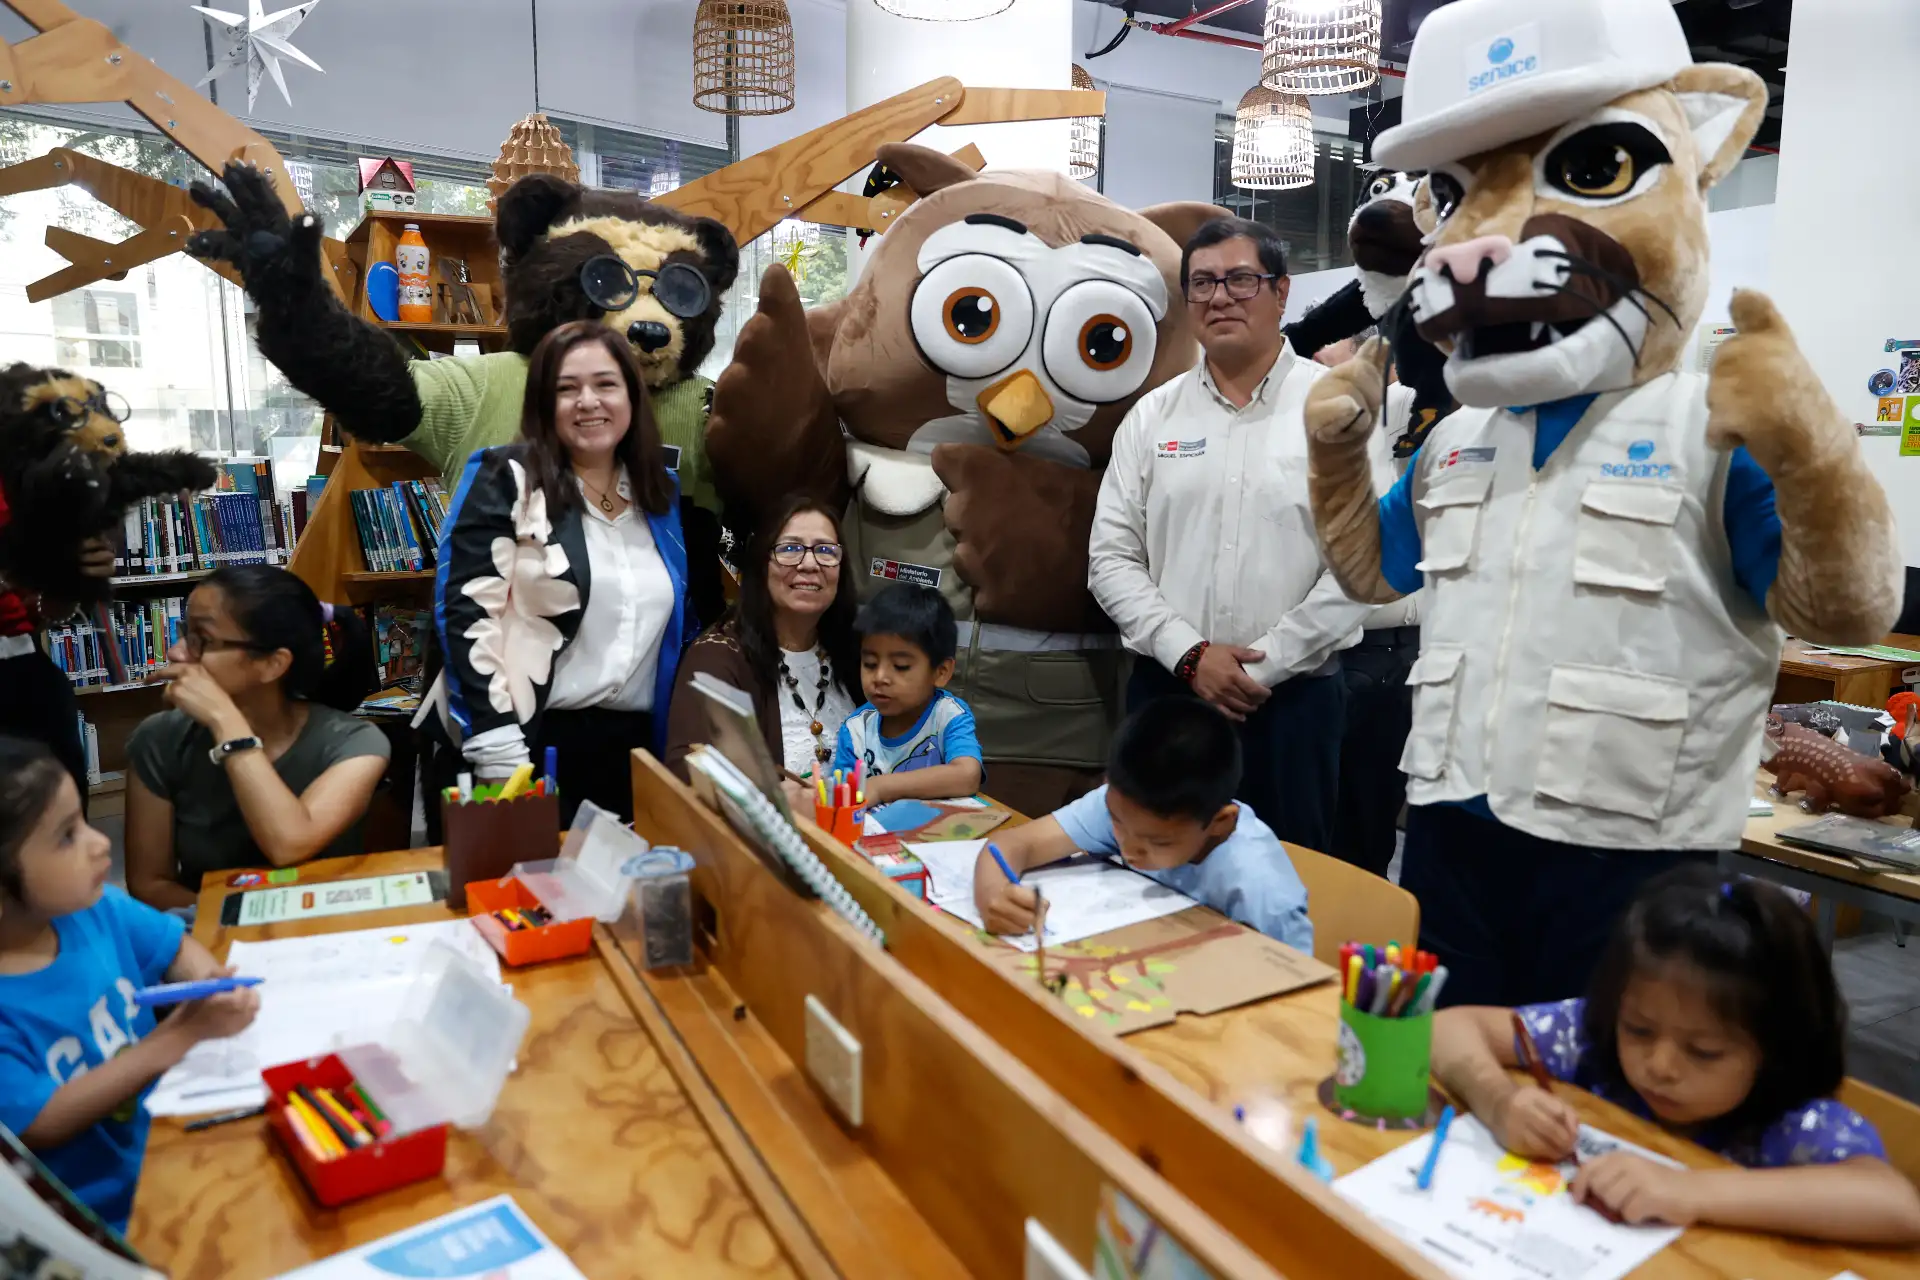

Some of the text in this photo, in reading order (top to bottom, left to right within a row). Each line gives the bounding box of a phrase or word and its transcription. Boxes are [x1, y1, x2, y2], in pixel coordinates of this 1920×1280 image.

[1468, 55, 1537, 91] senace
[1601, 463, 1673, 479] senace
[900, 567, 928, 577] Ministerio
[908, 574, 934, 585] Ambiente
